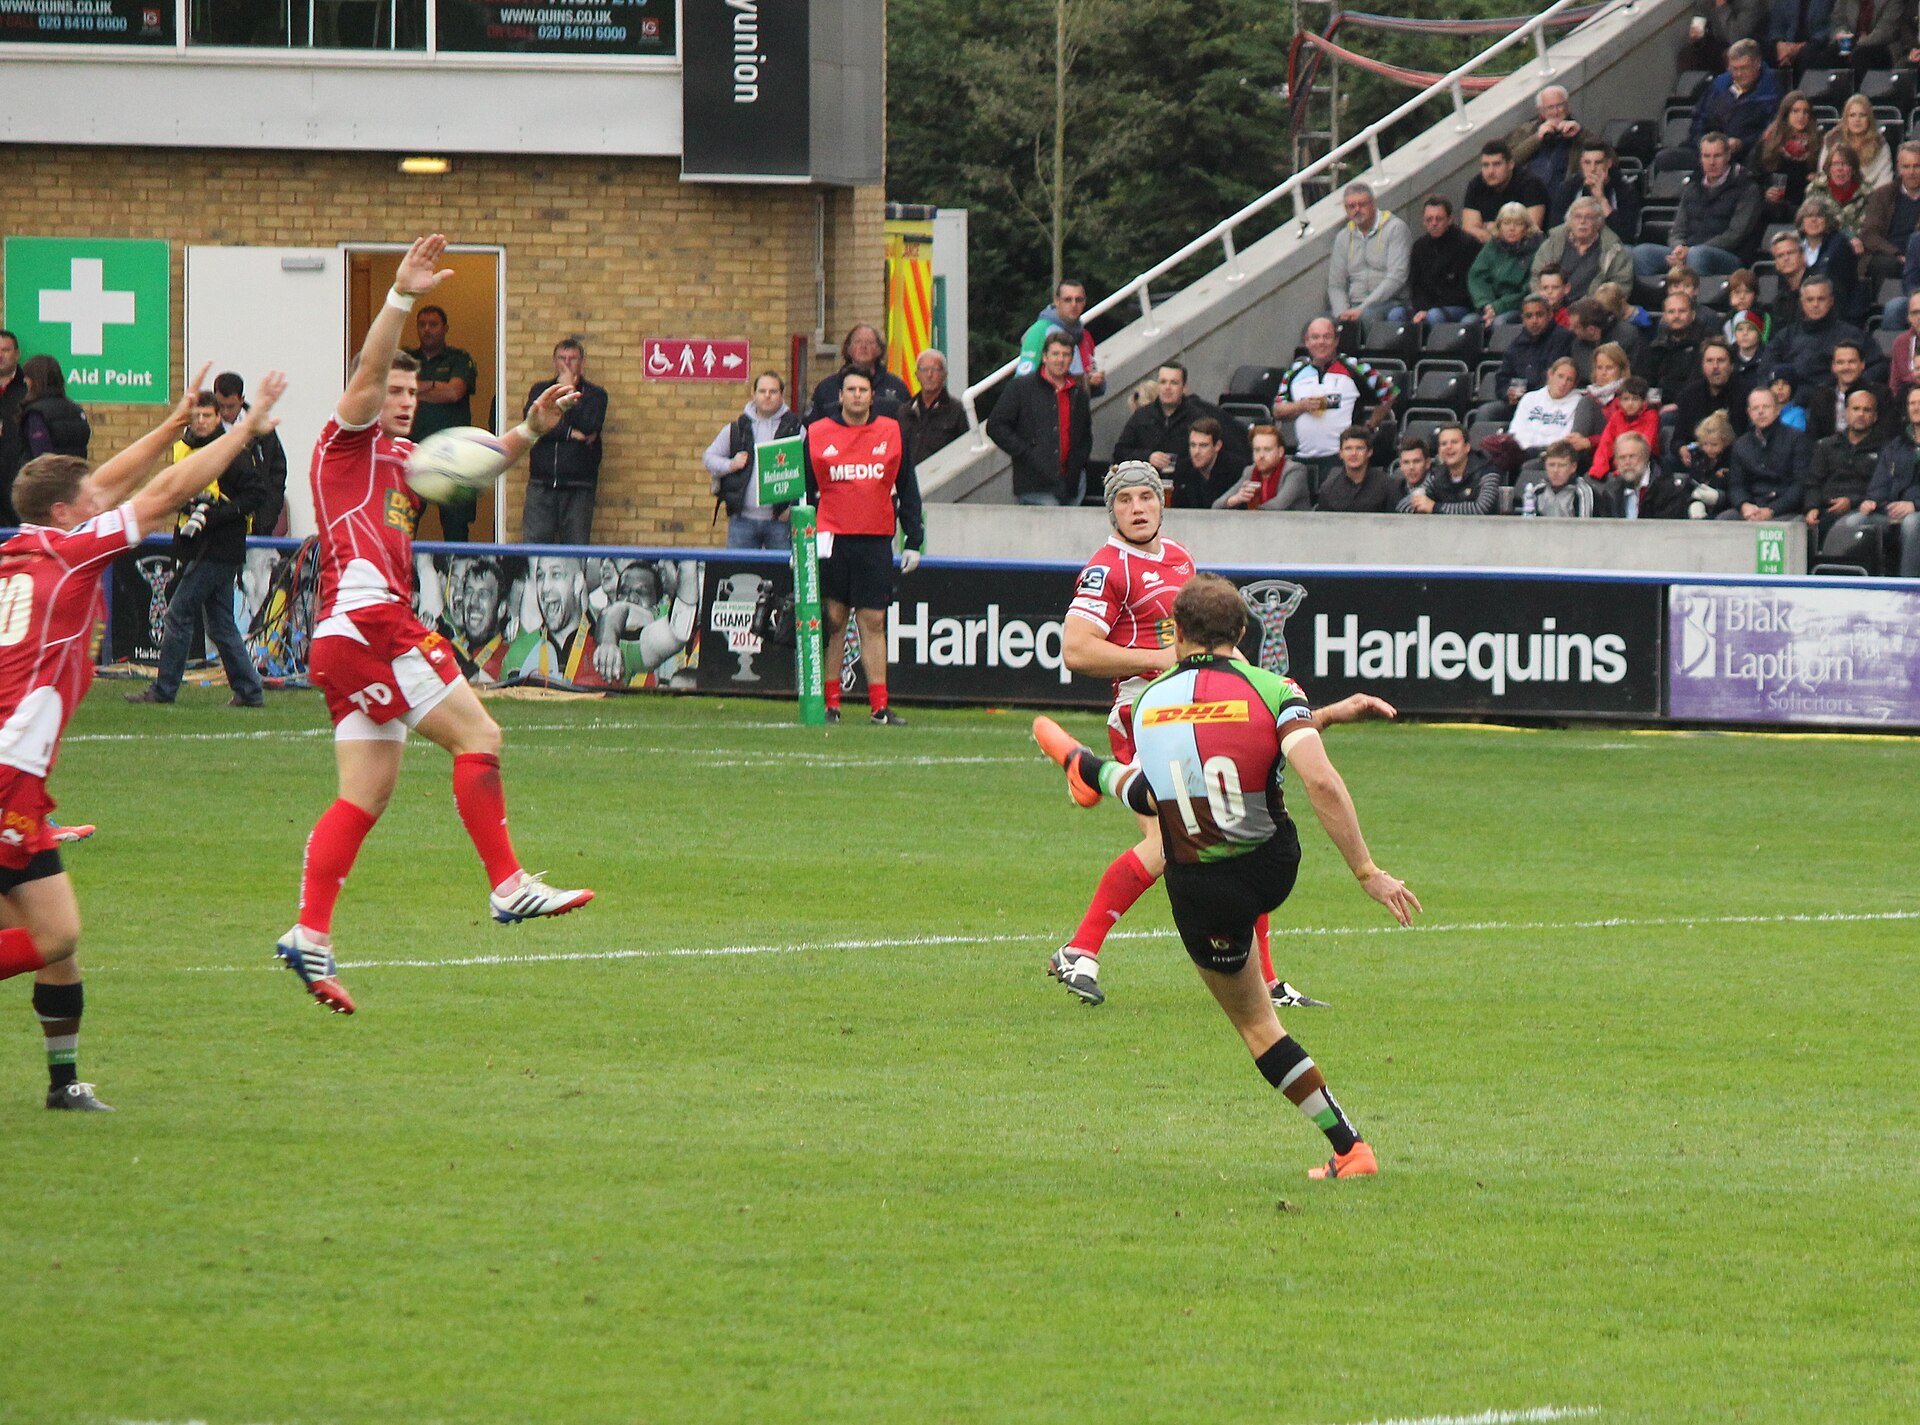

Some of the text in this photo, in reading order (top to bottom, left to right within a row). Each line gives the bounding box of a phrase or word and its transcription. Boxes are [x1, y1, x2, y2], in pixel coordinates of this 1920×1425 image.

[38, 15, 61, 30] 020
[64, 16, 94, 31] 8410
[97, 16, 128, 32] 6000
[538, 25, 561, 39] 020
[564, 26, 593, 40] 8410
[595, 26, 627, 41] 6000
[67, 369, 153, 386] Aid Point
[763, 465, 800, 484] Heineken
[829, 463, 885, 482] MEDIC
[773, 481, 789, 495] CUP
[1761, 541, 1780, 561] FA
[804, 541, 818, 604] Heineken
[713, 612, 751, 627] CHAMP
[733, 632, 759, 647] 2012
[887, 601, 1072, 684] Harleq
[1314, 613, 1628, 695] Harlequins
[809, 633, 822, 696] Heineken
[1725, 642, 1854, 691] Lapthorn
[1154, 704, 1234, 723] DHL
[1169, 755, 1246, 836] 10
